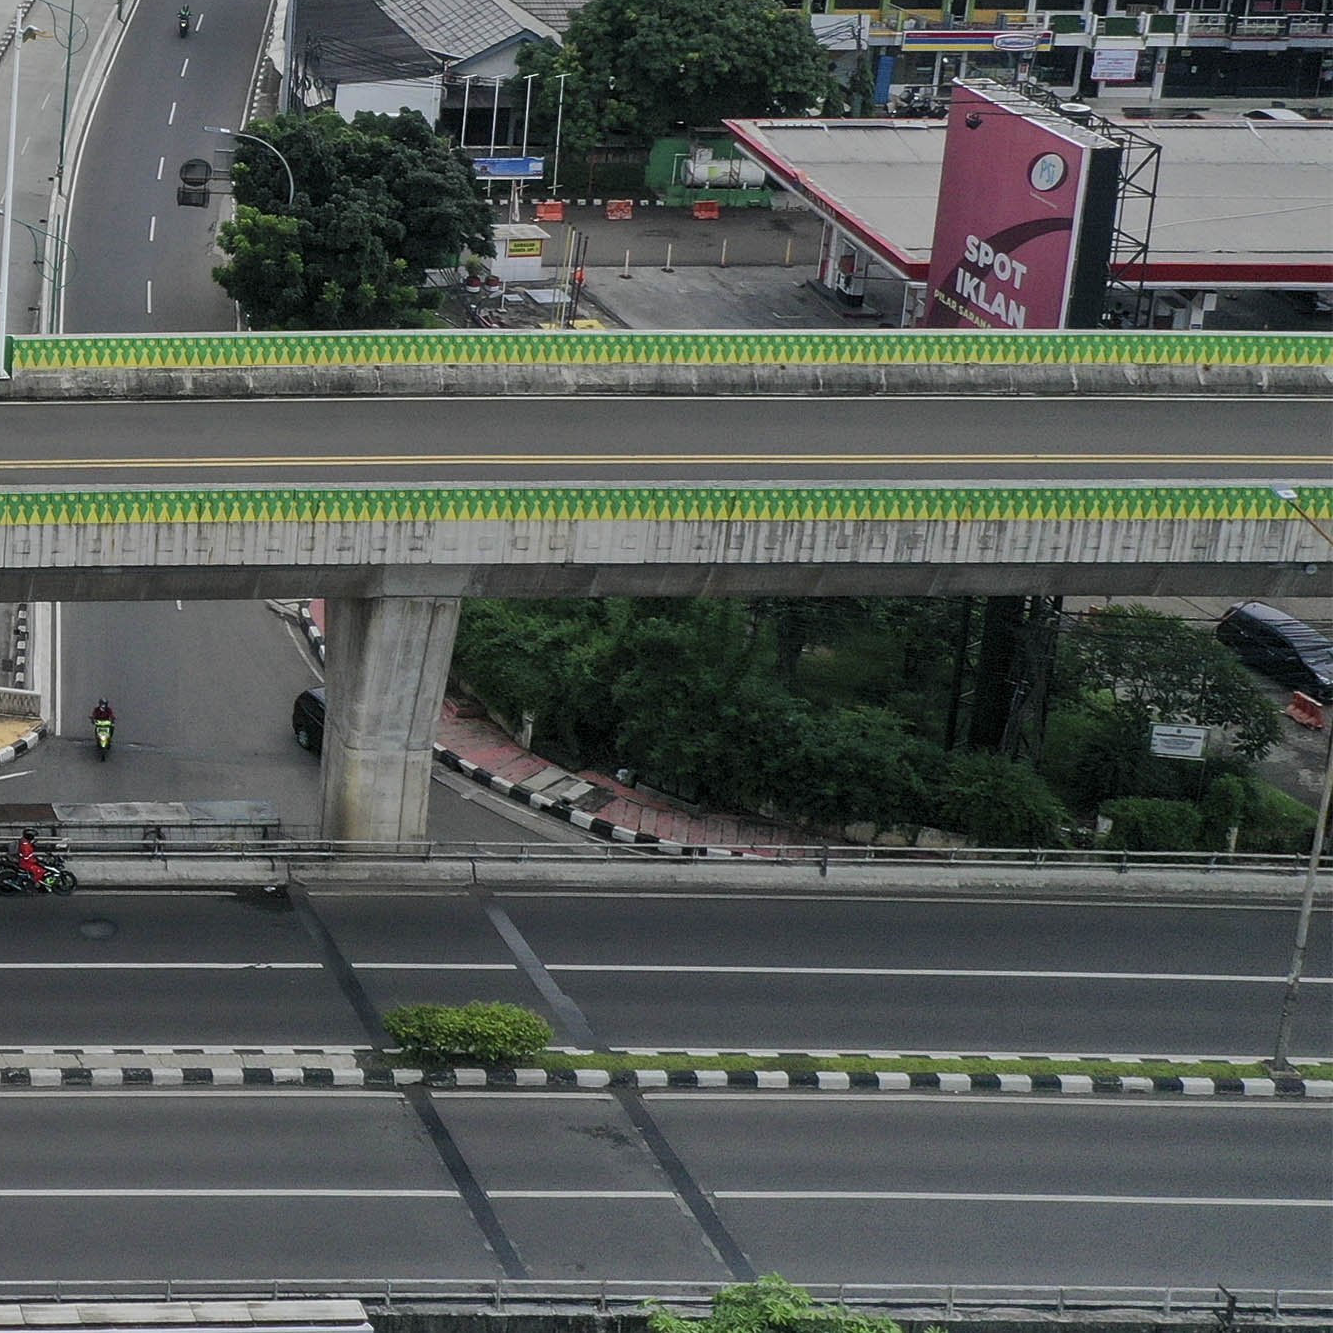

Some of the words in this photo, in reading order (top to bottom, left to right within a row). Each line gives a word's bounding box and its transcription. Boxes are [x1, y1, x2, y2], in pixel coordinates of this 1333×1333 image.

[964, 234, 1027, 290] SPOT
[933, 288, 957, 312] PILAR
[955, 266, 1026, 329] IKLAN
